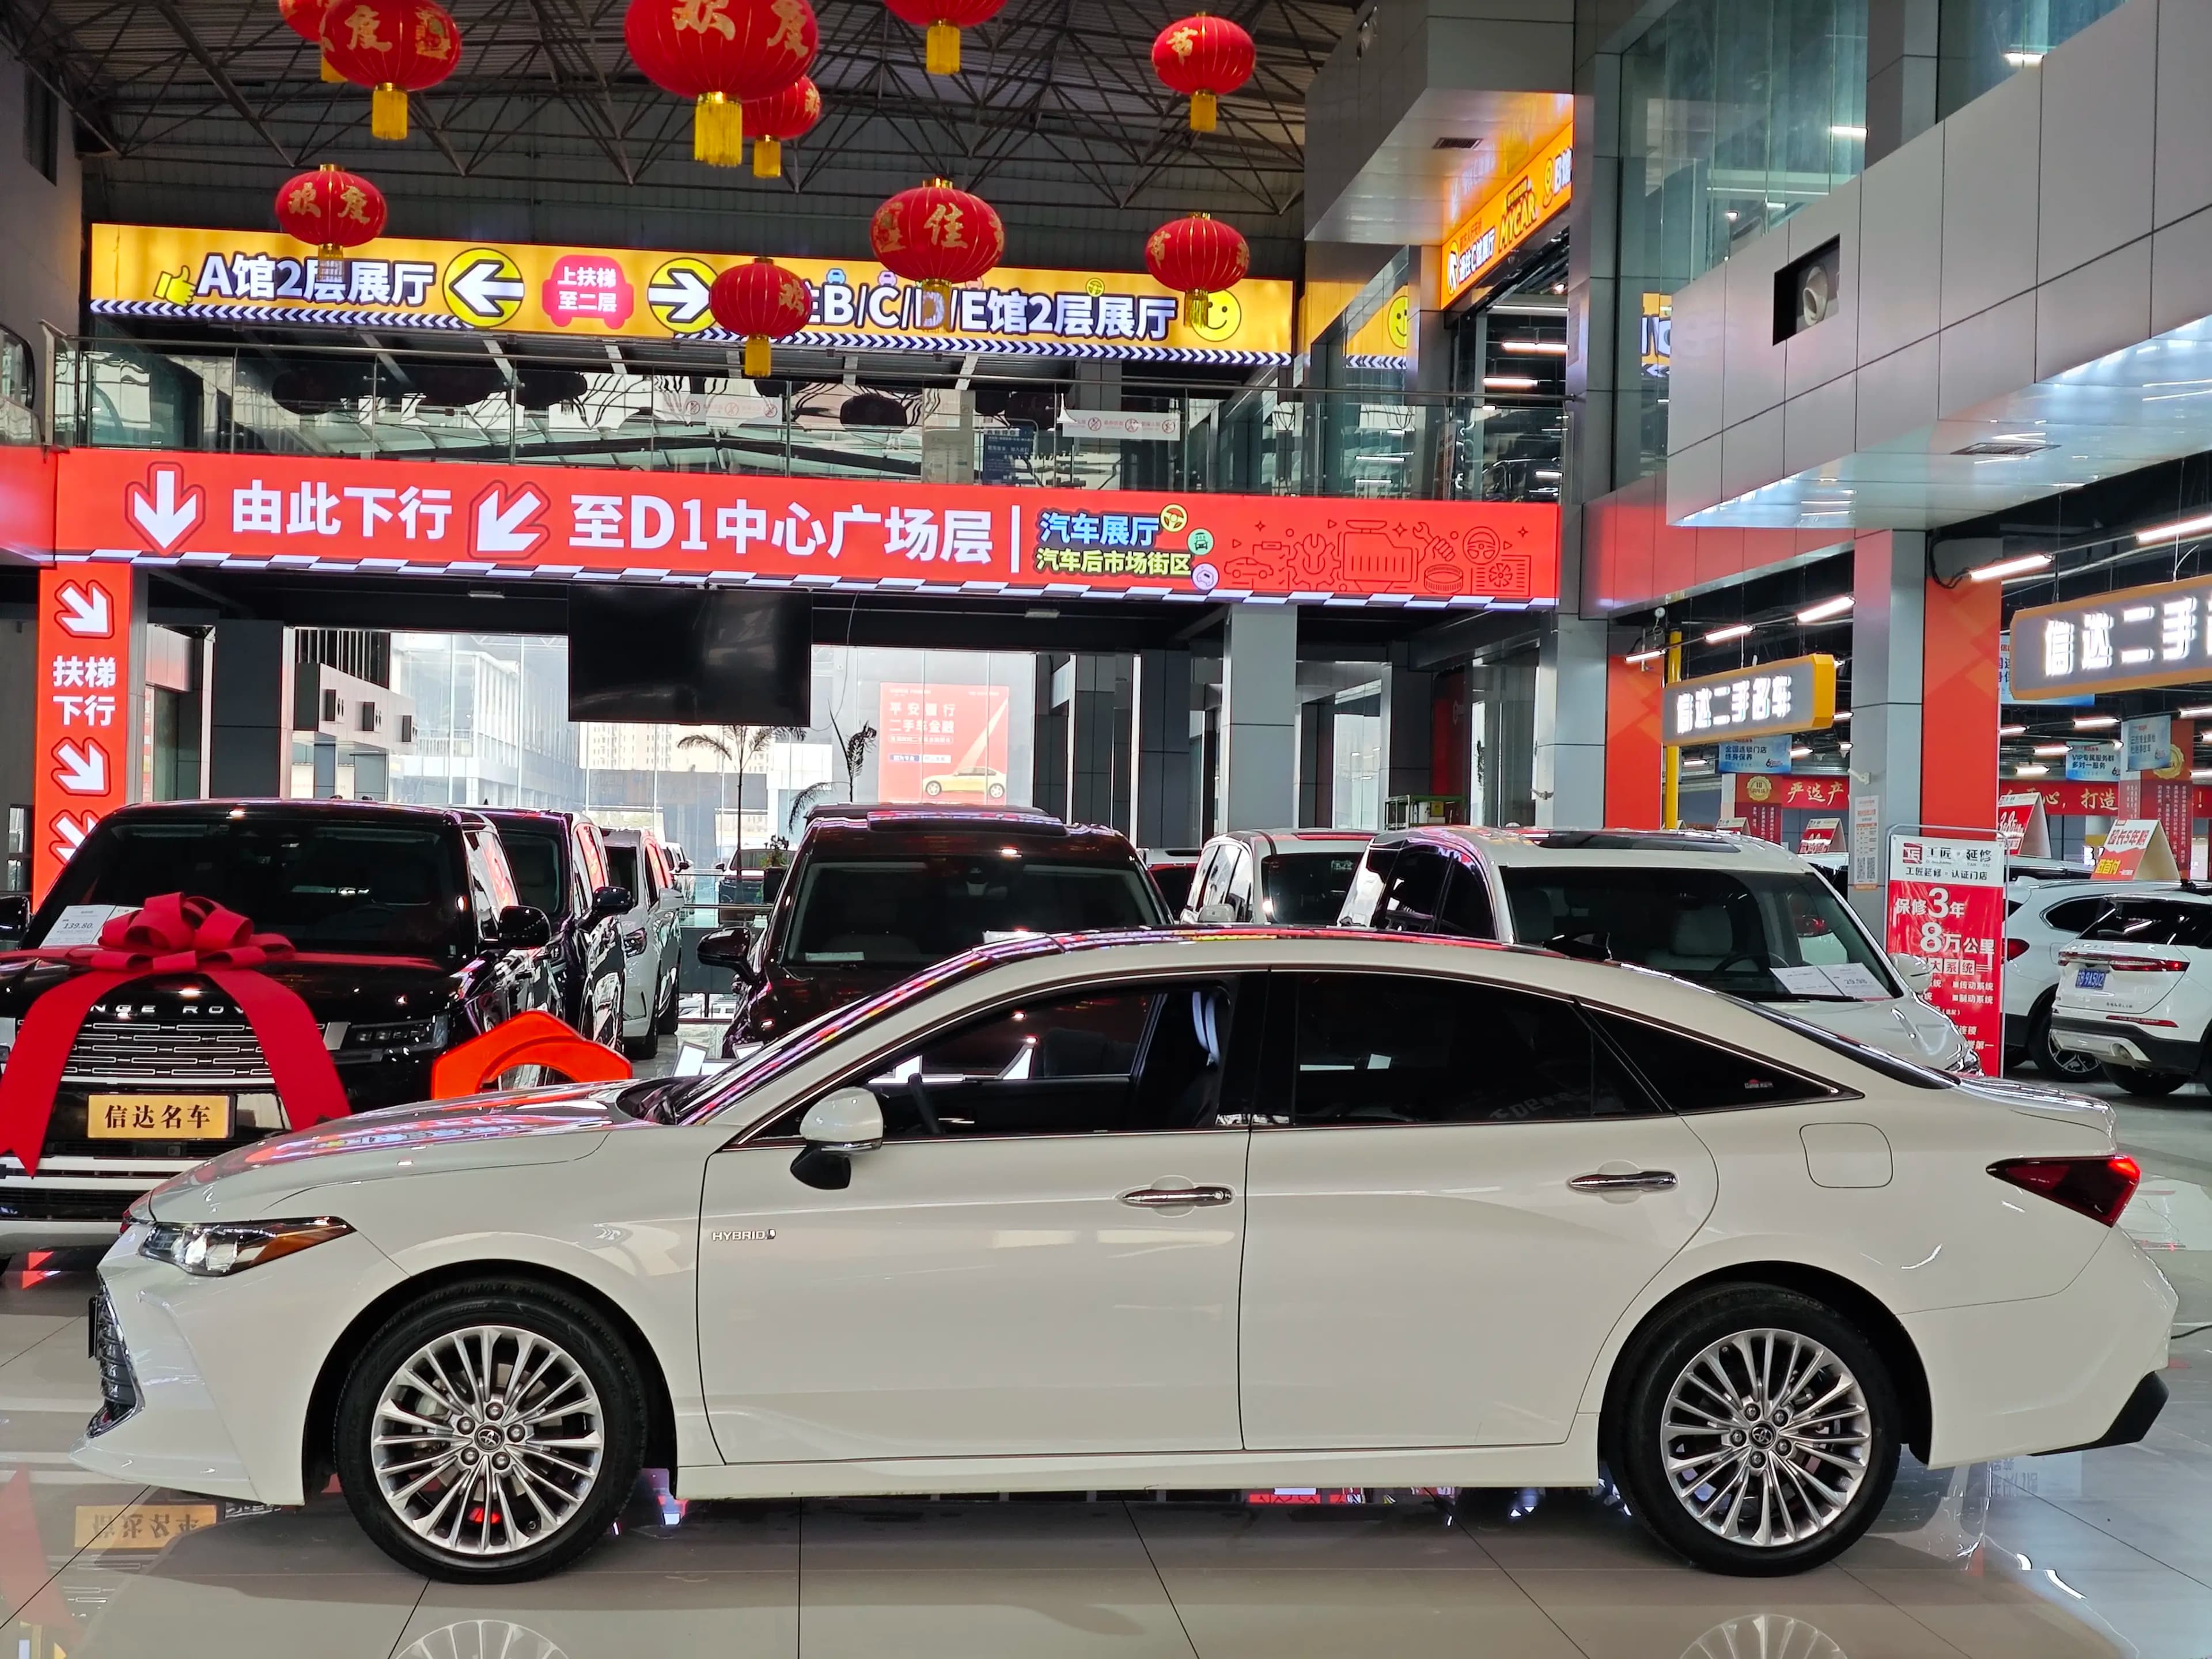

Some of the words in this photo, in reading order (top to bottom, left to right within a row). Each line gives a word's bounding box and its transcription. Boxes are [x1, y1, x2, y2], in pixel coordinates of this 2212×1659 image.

[924, 203, 968, 249] 佳
[197, 253, 434, 305] A馆2层展厅
[556, 266, 617, 287] 上扶梯
[558, 290, 618, 313] 至二层
[232, 479, 452, 540] 由此下行
[569, 494, 993, 565] 至D1中心广场层
[1039, 511, 1160, 547] 汽车展厅
[1036, 547, 1192, 575] 汽车后市场街区
[2046, 593, 2212, 676] 信达二手
[52, 655, 117, 689] 扶梯
[52, 695, 116, 727] 下行
[1677, 676, 1791, 734] 信达二手名车
[1895, 887, 1965, 918] 保修3年
[1920, 922, 1995, 955] 8万公里
[1955, 1025, 1978, 1035] 连锁
[104, 1104, 211, 1129] 信达名车
[712, 1230, 766, 1241] HYBRID
